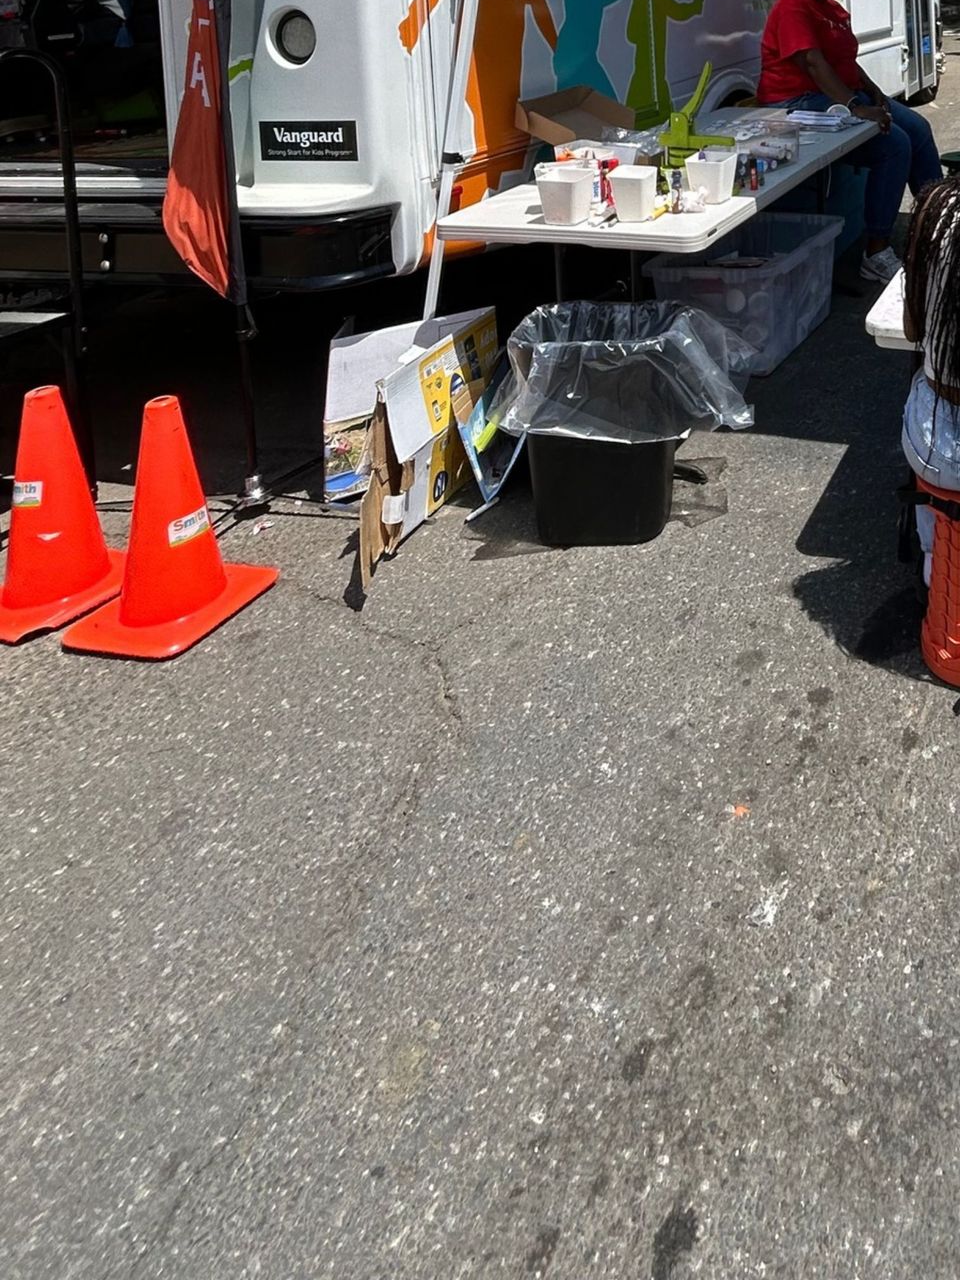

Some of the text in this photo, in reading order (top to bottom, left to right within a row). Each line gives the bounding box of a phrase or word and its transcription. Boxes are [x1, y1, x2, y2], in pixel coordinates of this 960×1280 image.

[273, 127, 343, 148] Vanguard
[267, 148, 286, 157] Strong
[287, 148, 301, 156] Start
[302, 148, 311, 156] for
[312, 148, 324, 156] Kids
[173, 510, 206, 532] Smith
